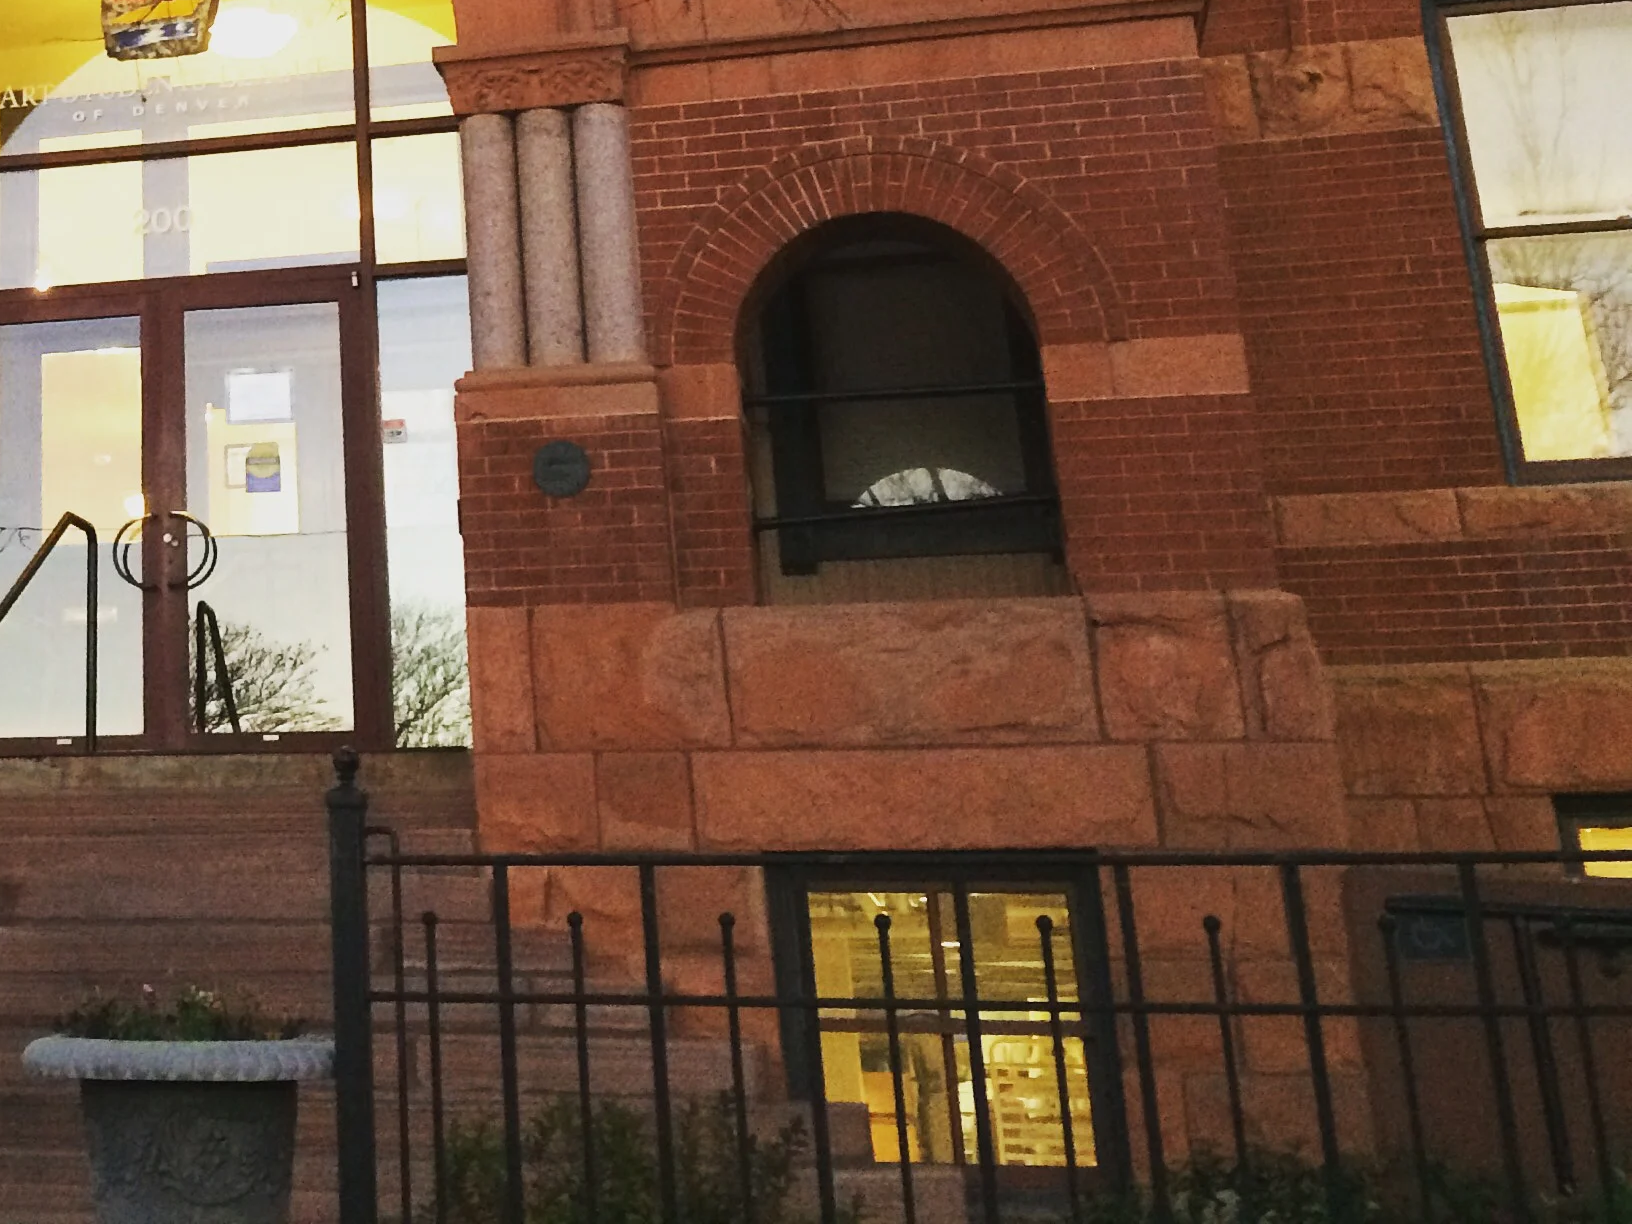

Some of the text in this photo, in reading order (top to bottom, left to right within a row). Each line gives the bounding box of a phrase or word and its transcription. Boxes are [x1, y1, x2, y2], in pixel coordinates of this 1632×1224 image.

[72, 94, 250, 123] OF DENVER
[132, 206, 195, 235] 200
